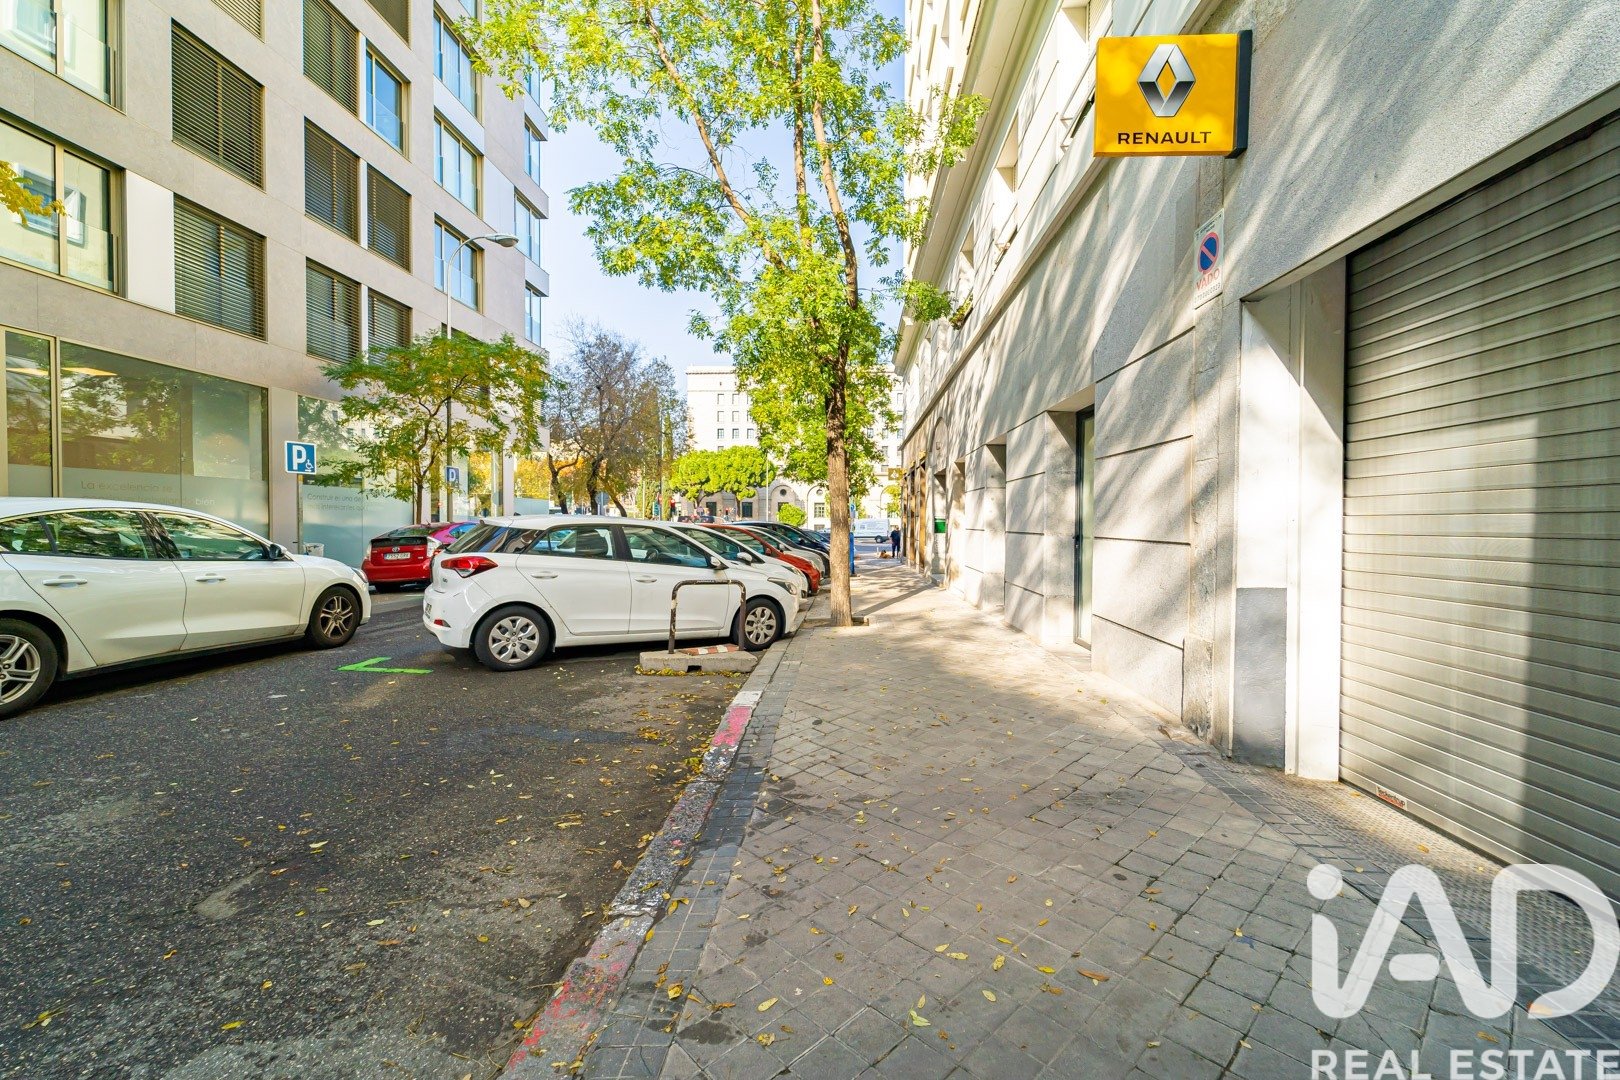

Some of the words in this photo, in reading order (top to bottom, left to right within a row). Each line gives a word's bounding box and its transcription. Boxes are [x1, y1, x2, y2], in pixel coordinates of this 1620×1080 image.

[1117, 131, 1212, 145] RENAULT
[1196, 268, 1220, 291] VADO
[292, 444, 307, 471] P
[81, 481, 95, 490] La
[98, 482, 159, 492] excelencia
[195, 497, 216, 506] bien
